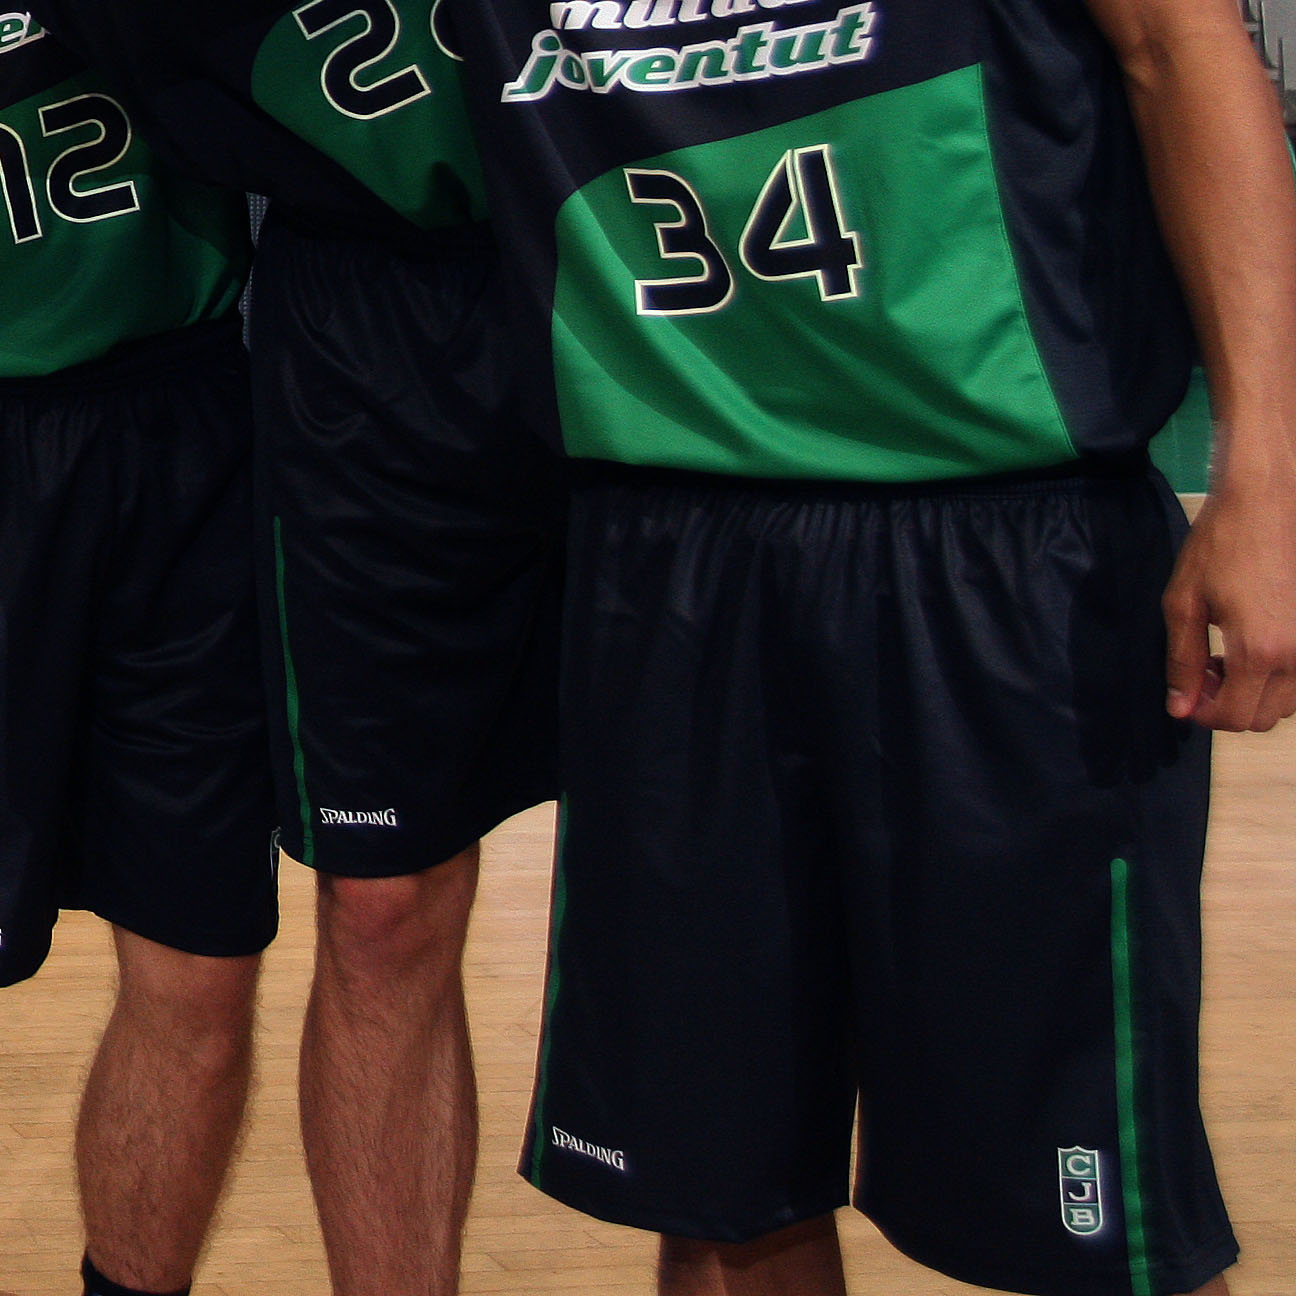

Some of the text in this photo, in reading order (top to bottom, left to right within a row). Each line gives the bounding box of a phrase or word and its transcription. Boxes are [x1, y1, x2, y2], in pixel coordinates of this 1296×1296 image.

[500, 1, 879, 104] joventut
[621, 142, 864, 317] 34
[319, 807, 398, 828] SPALDING
[550, 1125, 626, 1172] SPALDING
